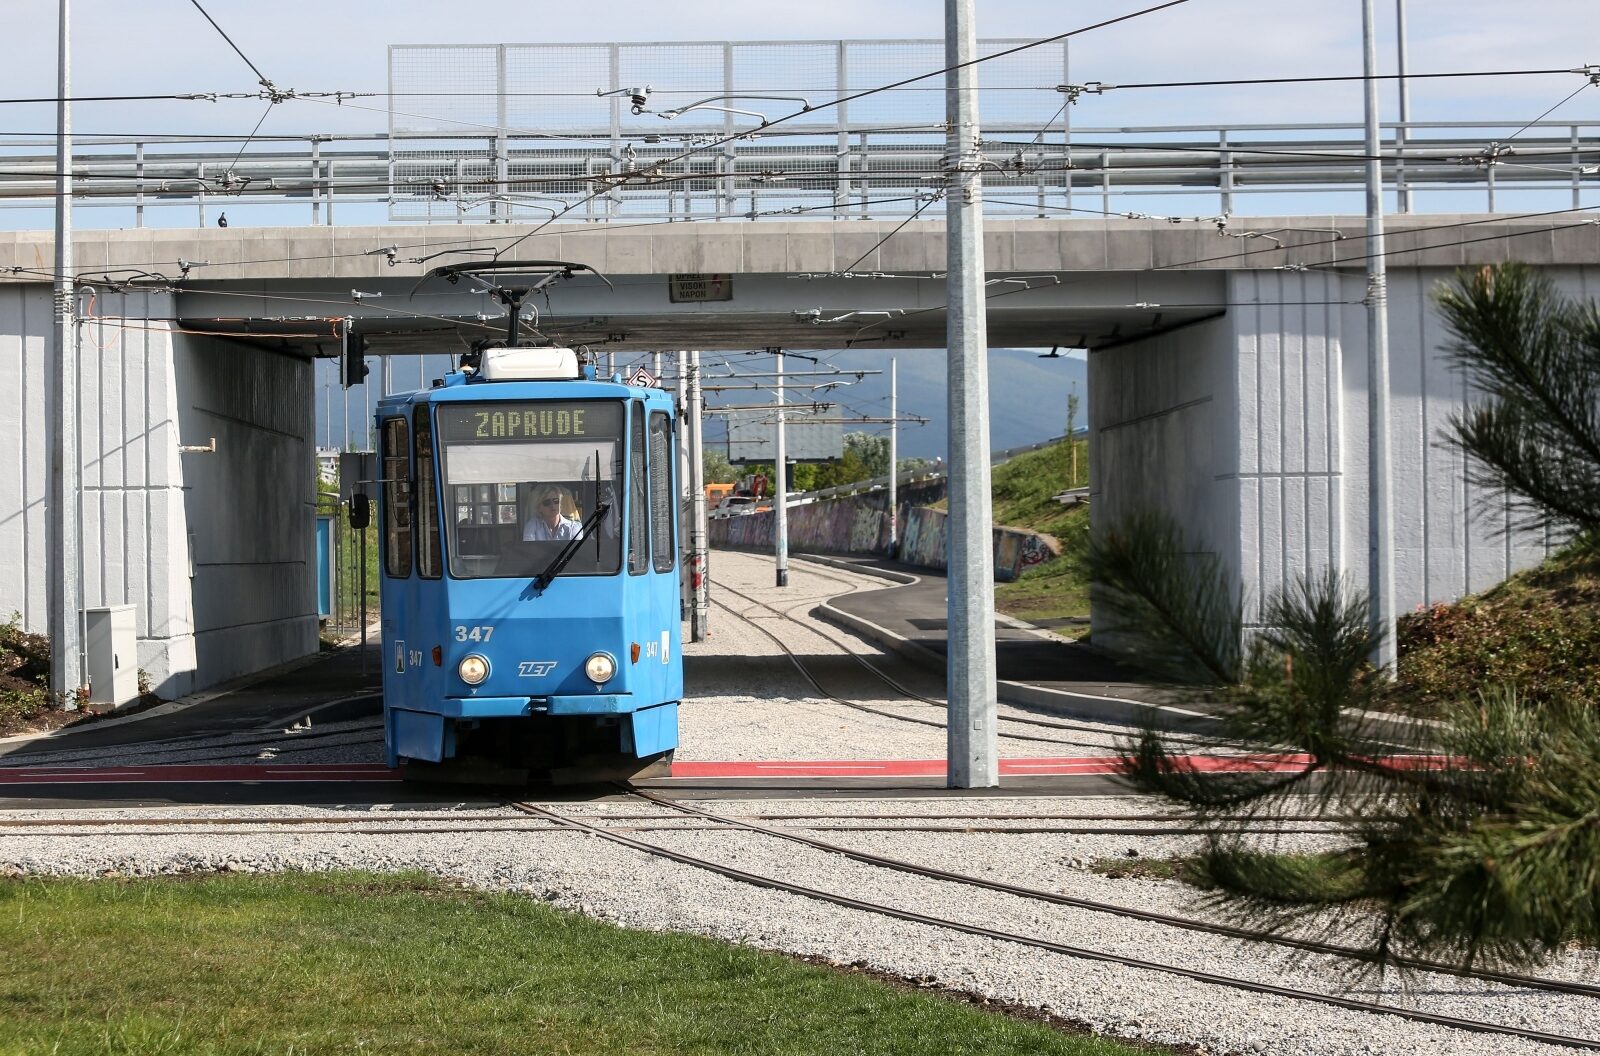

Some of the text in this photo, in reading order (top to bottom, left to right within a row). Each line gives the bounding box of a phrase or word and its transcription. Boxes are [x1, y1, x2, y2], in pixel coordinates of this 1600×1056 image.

[680, 281, 706, 290] VISOKI
[680, 290, 706, 299] NAPON
[636, 375, 648, 387] S
[474, 409, 585, 437] ZAPRUĐE
[455, 626, 494, 643] 347
[646, 641, 658, 658] 347
[409, 649, 423, 667] 347
[518, 661, 559, 677] ZET
